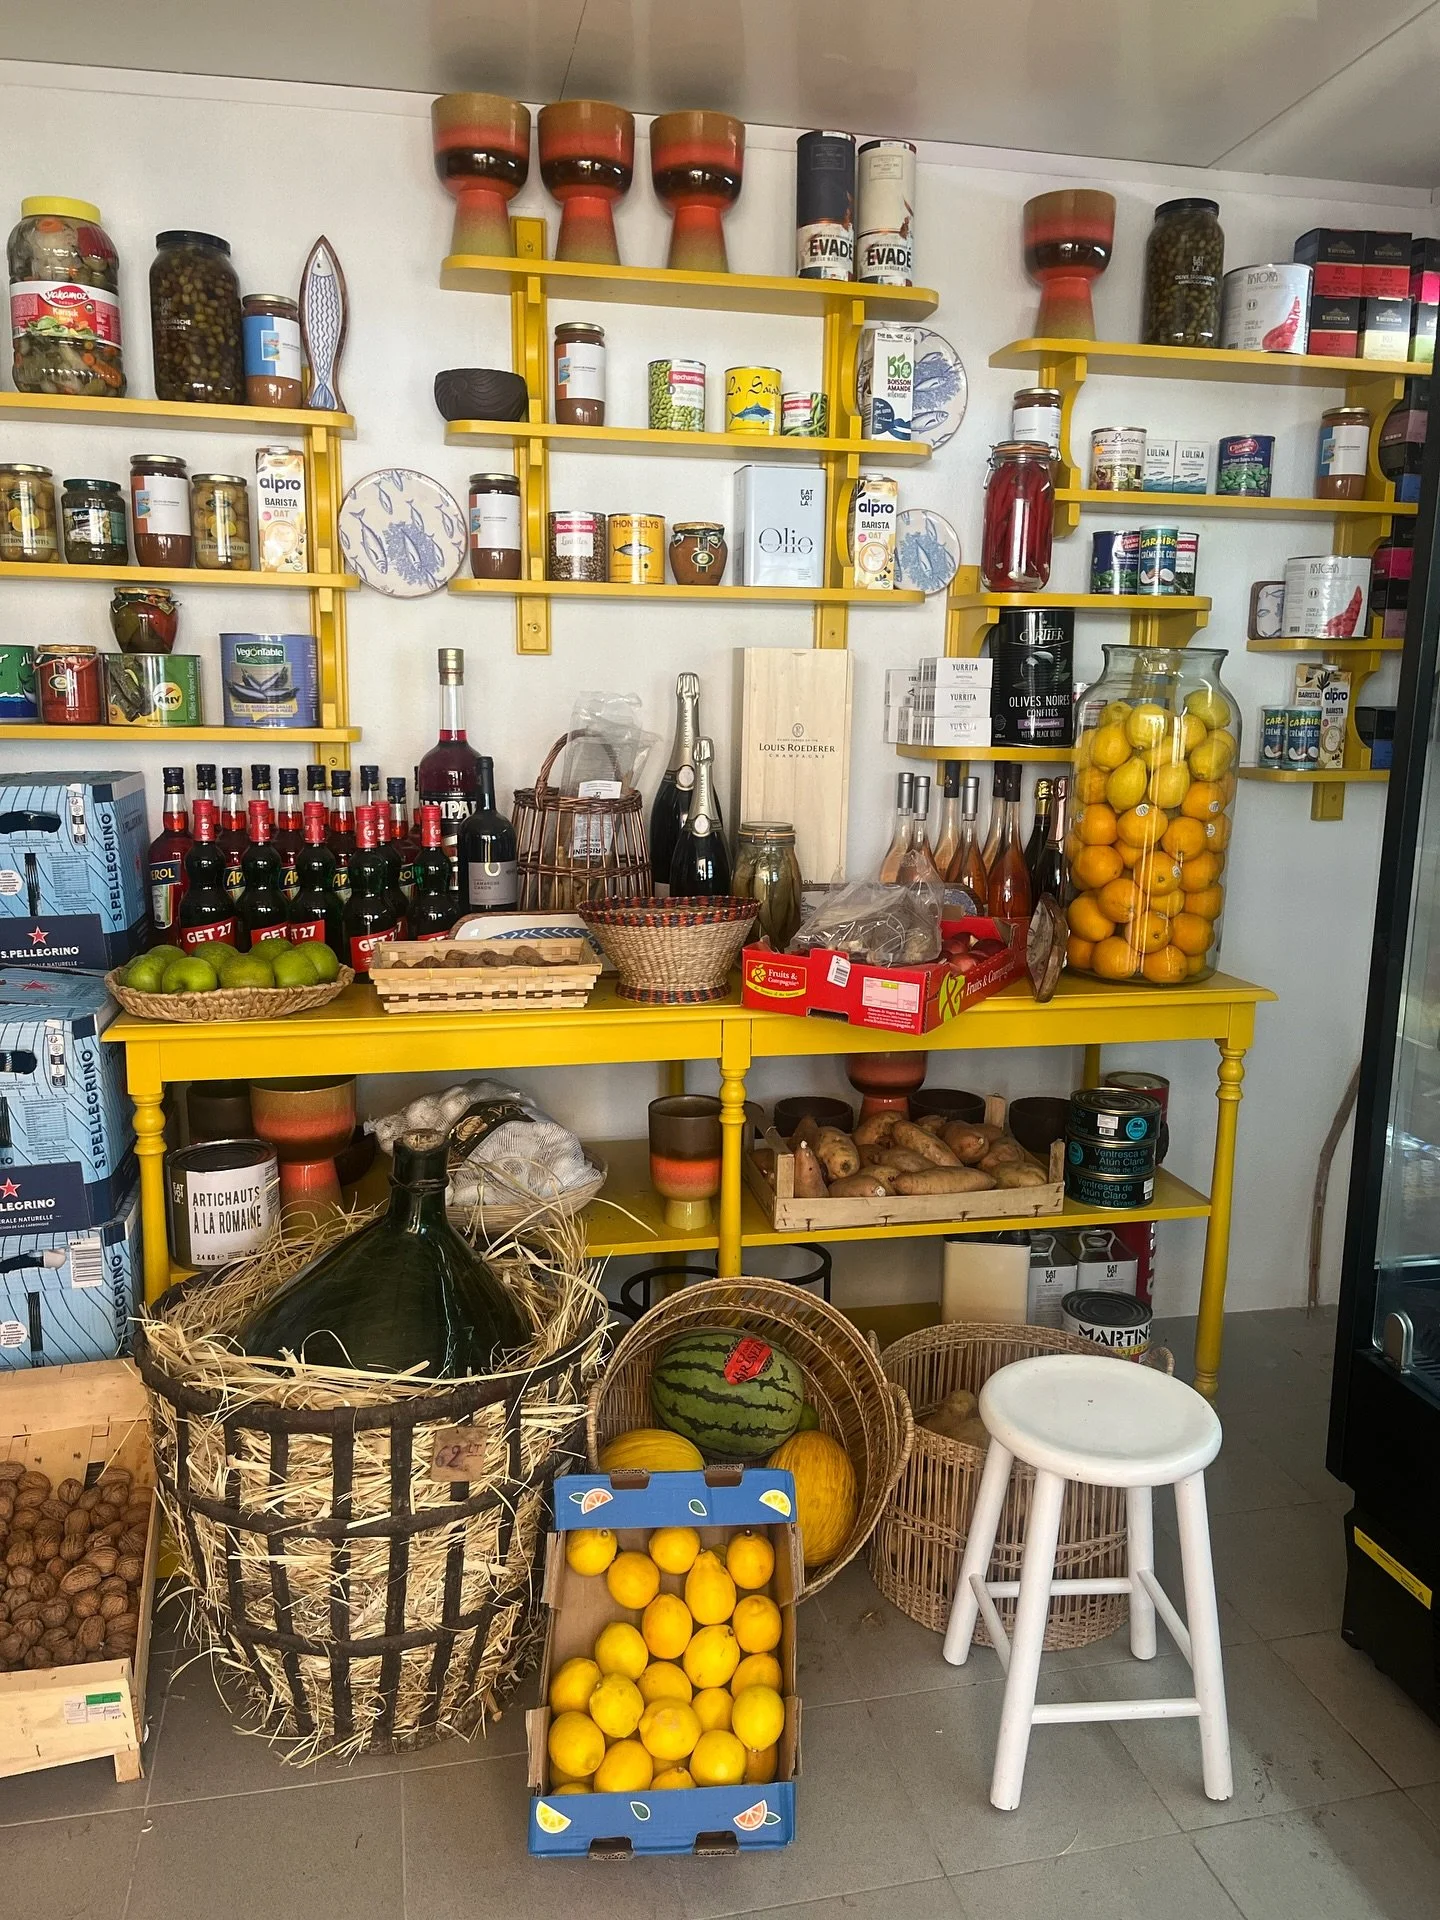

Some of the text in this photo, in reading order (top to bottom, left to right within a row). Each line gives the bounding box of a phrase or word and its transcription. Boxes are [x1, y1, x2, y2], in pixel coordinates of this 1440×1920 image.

[259, 475, 302, 493] alpro
[264, 497, 298, 507] BARISTA
[858, 499, 895, 517] alpro
[273, 509, 290, 518] OAT
[861, 521, 890, 530] BARISTA
[758, 527, 814, 555] Olio
[868, 531, 882, 539] OAT
[1009, 694, 1070, 707] OLIVES NOIRES
[1324, 688, 1348, 703] alpro
[1026, 708, 1058, 717] CONFITES
[759, 742, 835, 753] LOUIS ROEDERER
[100, 812, 122, 922] S.PELLEGRINO
[187, 921, 232, 944] GET 27
[301, 925, 316, 939] 27
[1, 946, 79, 959] S.PELLEGRINO
[768, 968, 790, 979] Fruits
[82, 1049, 105, 1170] S.PELLEGRINO
[1094, 1147, 1139, 1159] Ventresca
[1123, 1157, 1144, 1167] Claro
[1123, 1184, 1133, 1192] de
[193, 1186, 260, 1207] ARTICHAUTS
[1103, 1190, 1128, 1200] Claro
[18, 1214, 53, 1222] NATURELLE
[203, 1212, 216, 1234] LA
[219, 1205, 262, 1234] ROMAINE
